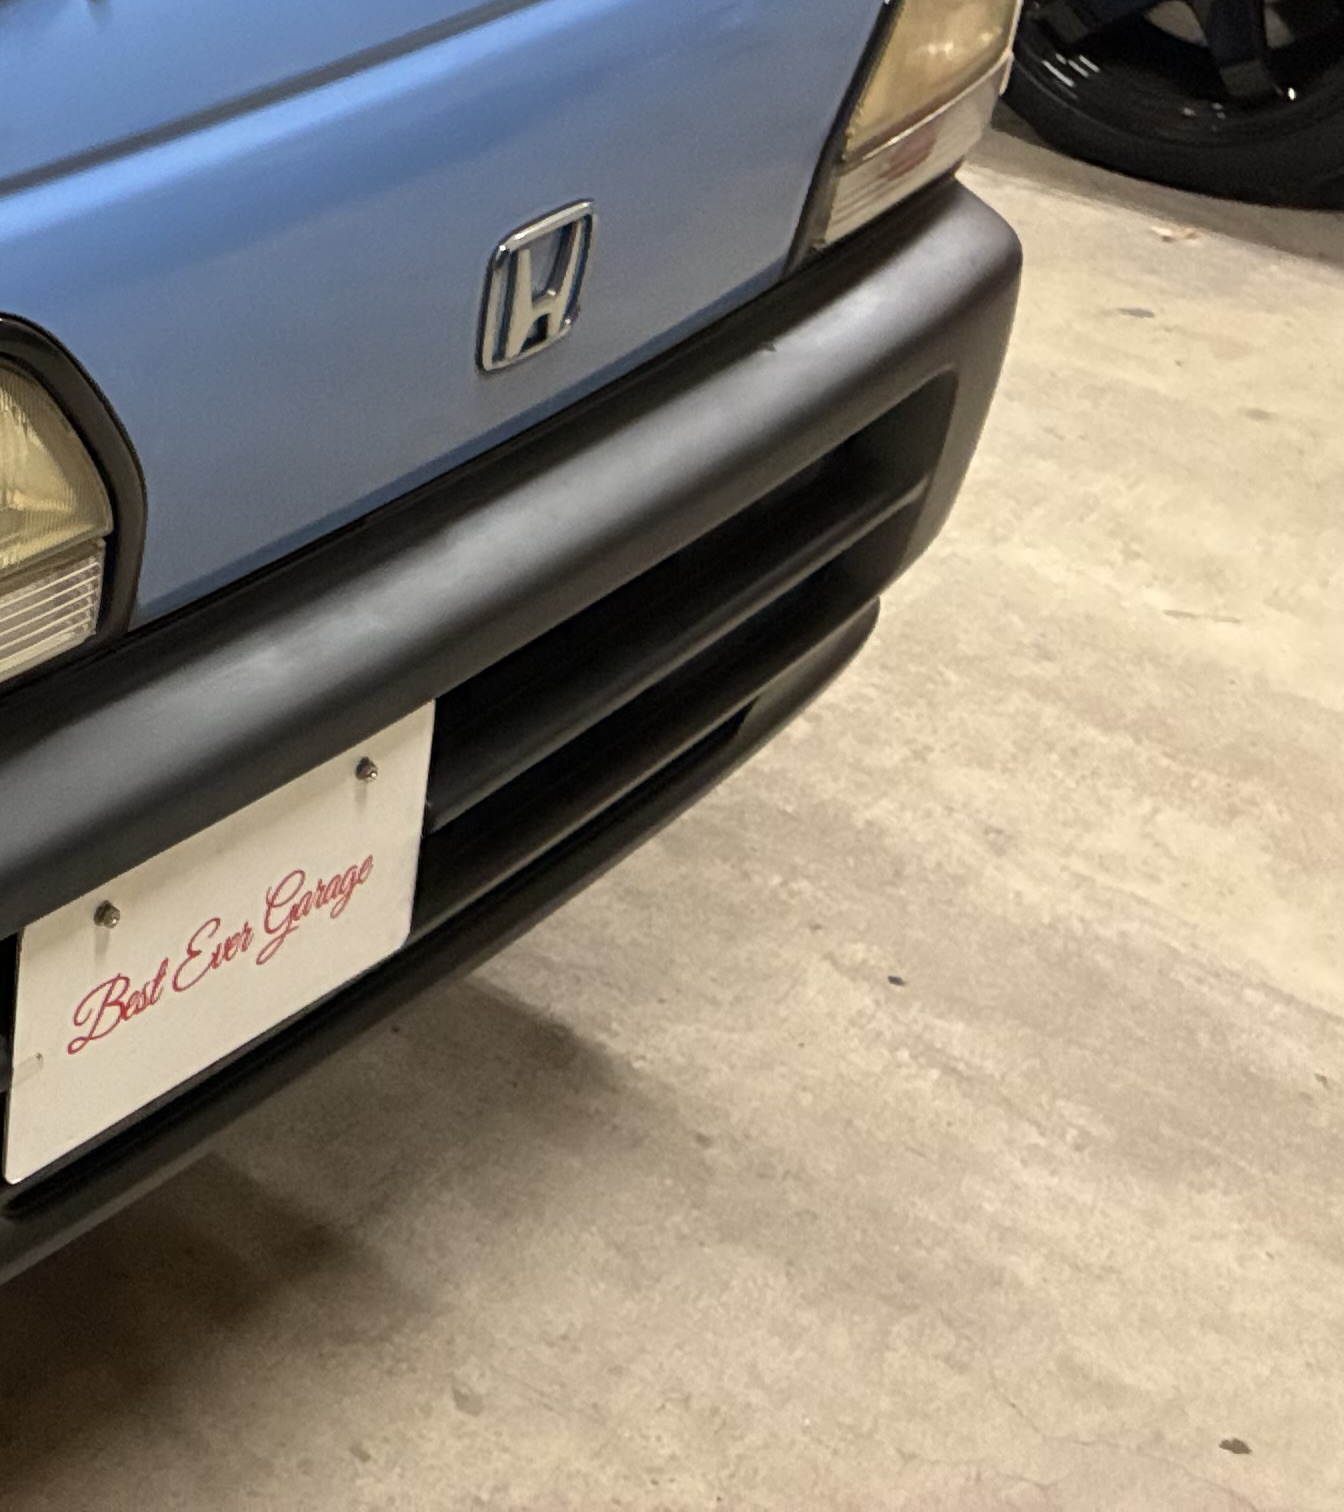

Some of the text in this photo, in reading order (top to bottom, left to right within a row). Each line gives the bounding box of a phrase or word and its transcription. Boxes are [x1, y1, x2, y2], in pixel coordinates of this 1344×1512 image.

[66, 854, 374, 1055] Best Ever Garage
